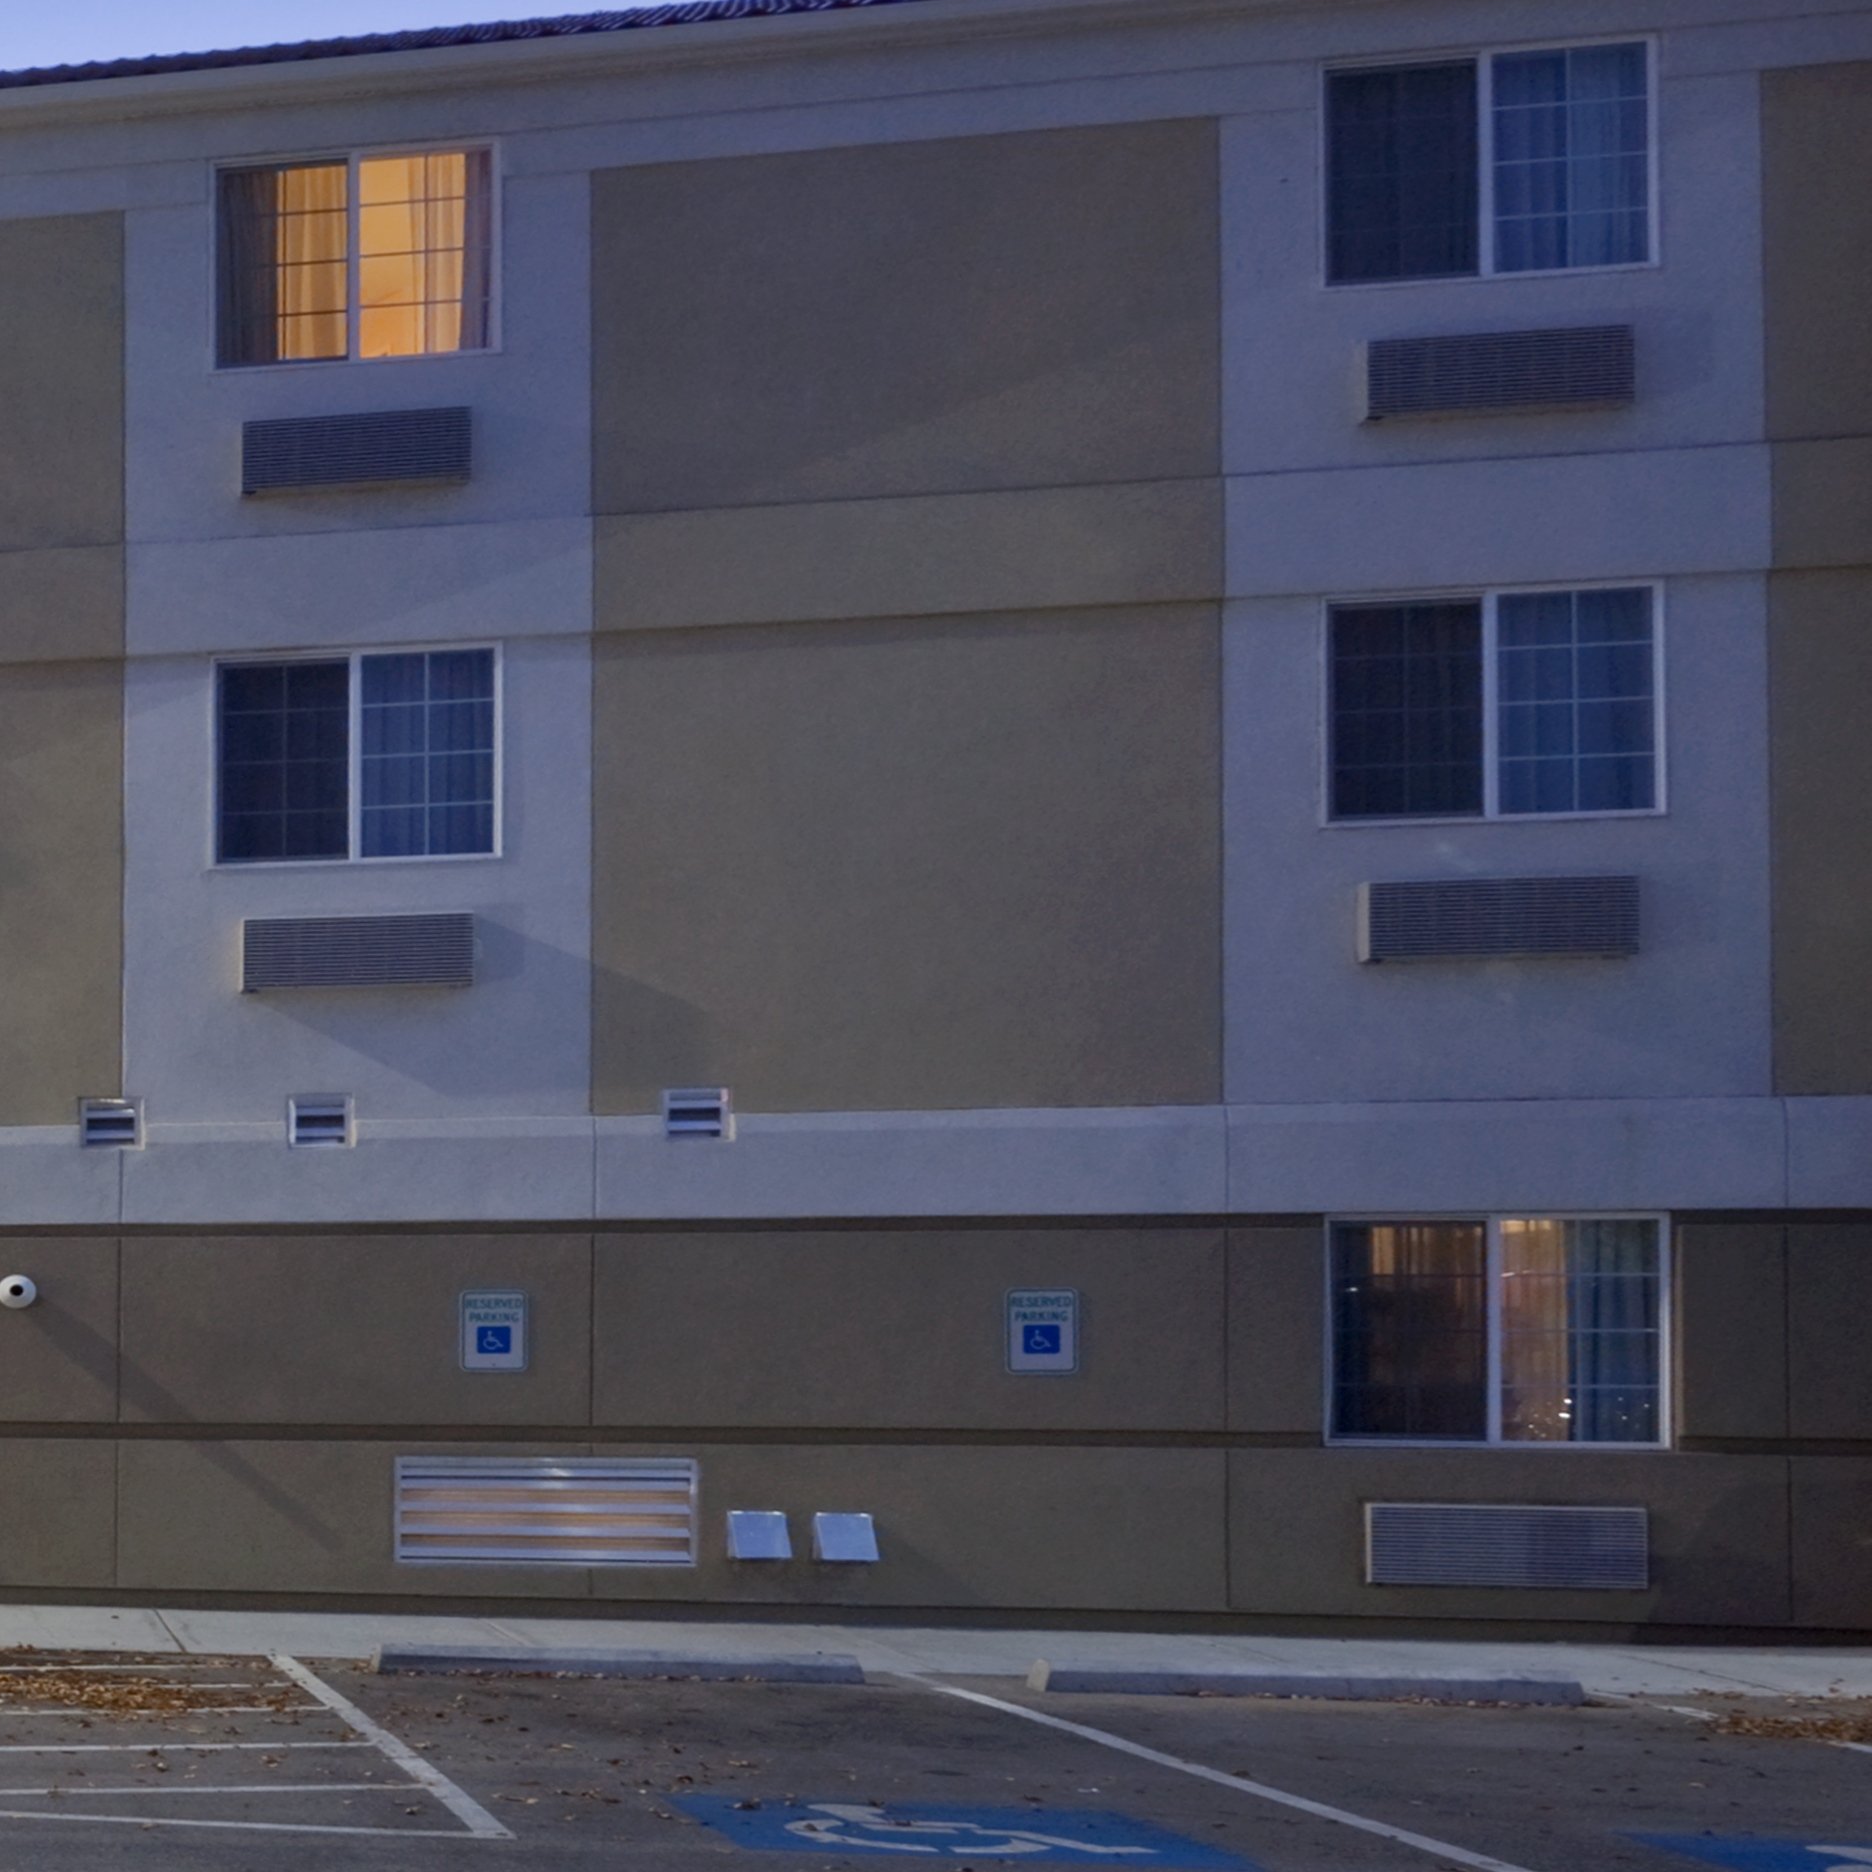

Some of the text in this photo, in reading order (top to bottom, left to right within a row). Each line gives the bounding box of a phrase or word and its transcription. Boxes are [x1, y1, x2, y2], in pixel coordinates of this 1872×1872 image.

[464, 1298, 522, 1309] RESERVED
[1011, 1296, 1072, 1307] RESERVED
[468, 1311, 520, 1322] PARKING
[1015, 1310, 1068, 1322] PARKING
